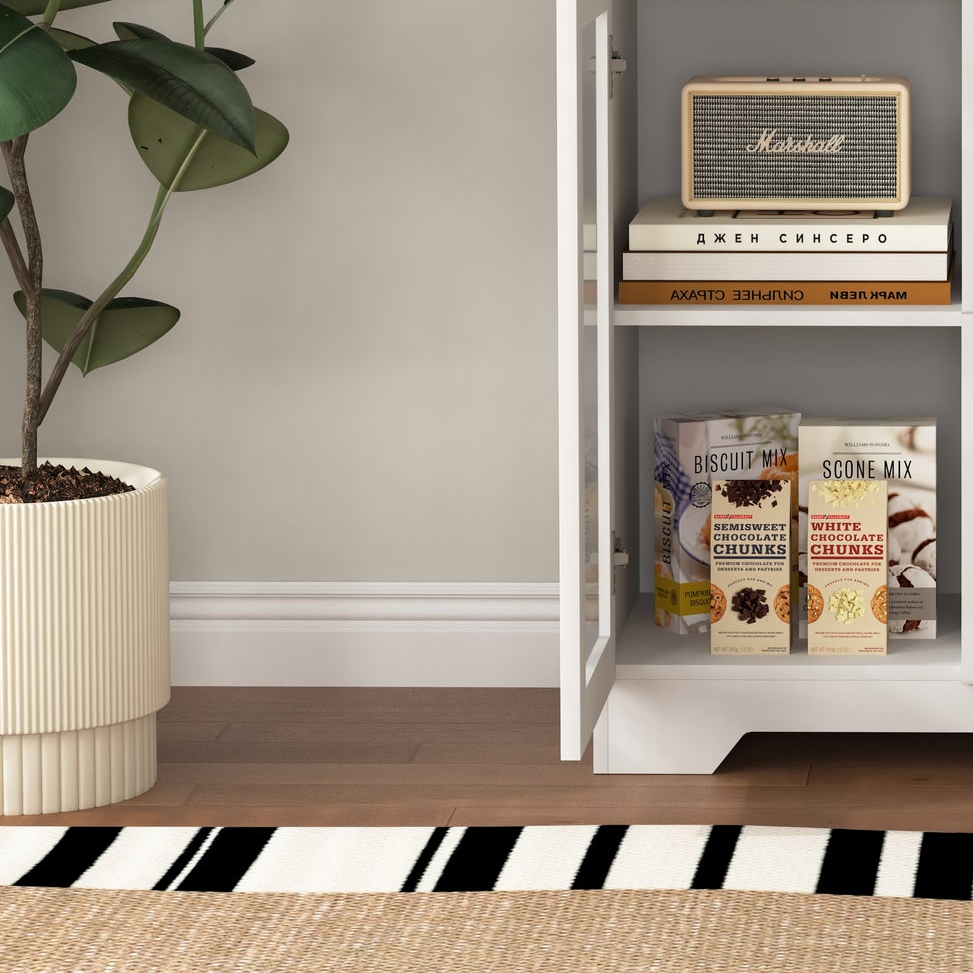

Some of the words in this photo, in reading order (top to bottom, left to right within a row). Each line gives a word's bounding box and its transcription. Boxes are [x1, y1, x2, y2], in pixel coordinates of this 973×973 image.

[746, 128, 846, 153] Marshall
[696, 233, 759, 244] ДЖЕН
[779, 233, 888, 244] СИНСЕРО
[694, 451, 754, 474] BISCUIT
[762, 448, 787, 468] MIX
[822, 460, 875, 479] SCONE
[884, 460, 912, 479] MIX
[713, 523, 787, 531] SEMISWEET
[811, 522, 862, 531] WHITE
[662, 501, 671, 565] BISCUIT
[713, 533, 787, 541] CHOCOLATE
[810, 533, 884, 541] CHOCOLATE
[713, 544, 787, 555] CHUNKS
[810, 544, 884, 555] CHUNKS
